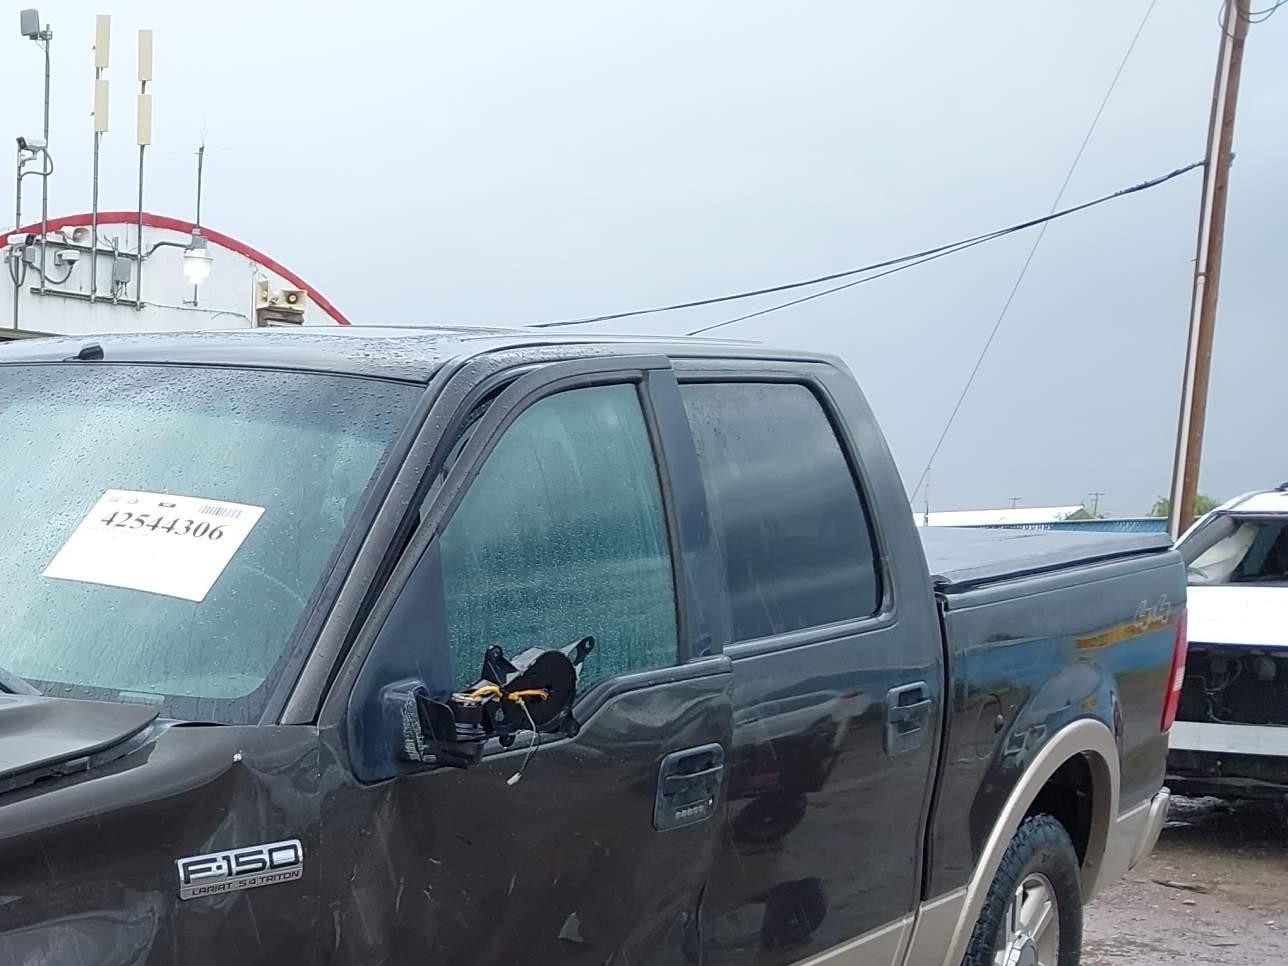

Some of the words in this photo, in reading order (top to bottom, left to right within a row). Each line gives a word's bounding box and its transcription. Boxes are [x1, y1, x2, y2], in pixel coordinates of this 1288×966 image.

[100, 511, 231, 541] 42544306
[192, 883, 233, 896] LARIAT
[260, 870, 300, 884] TRITON
